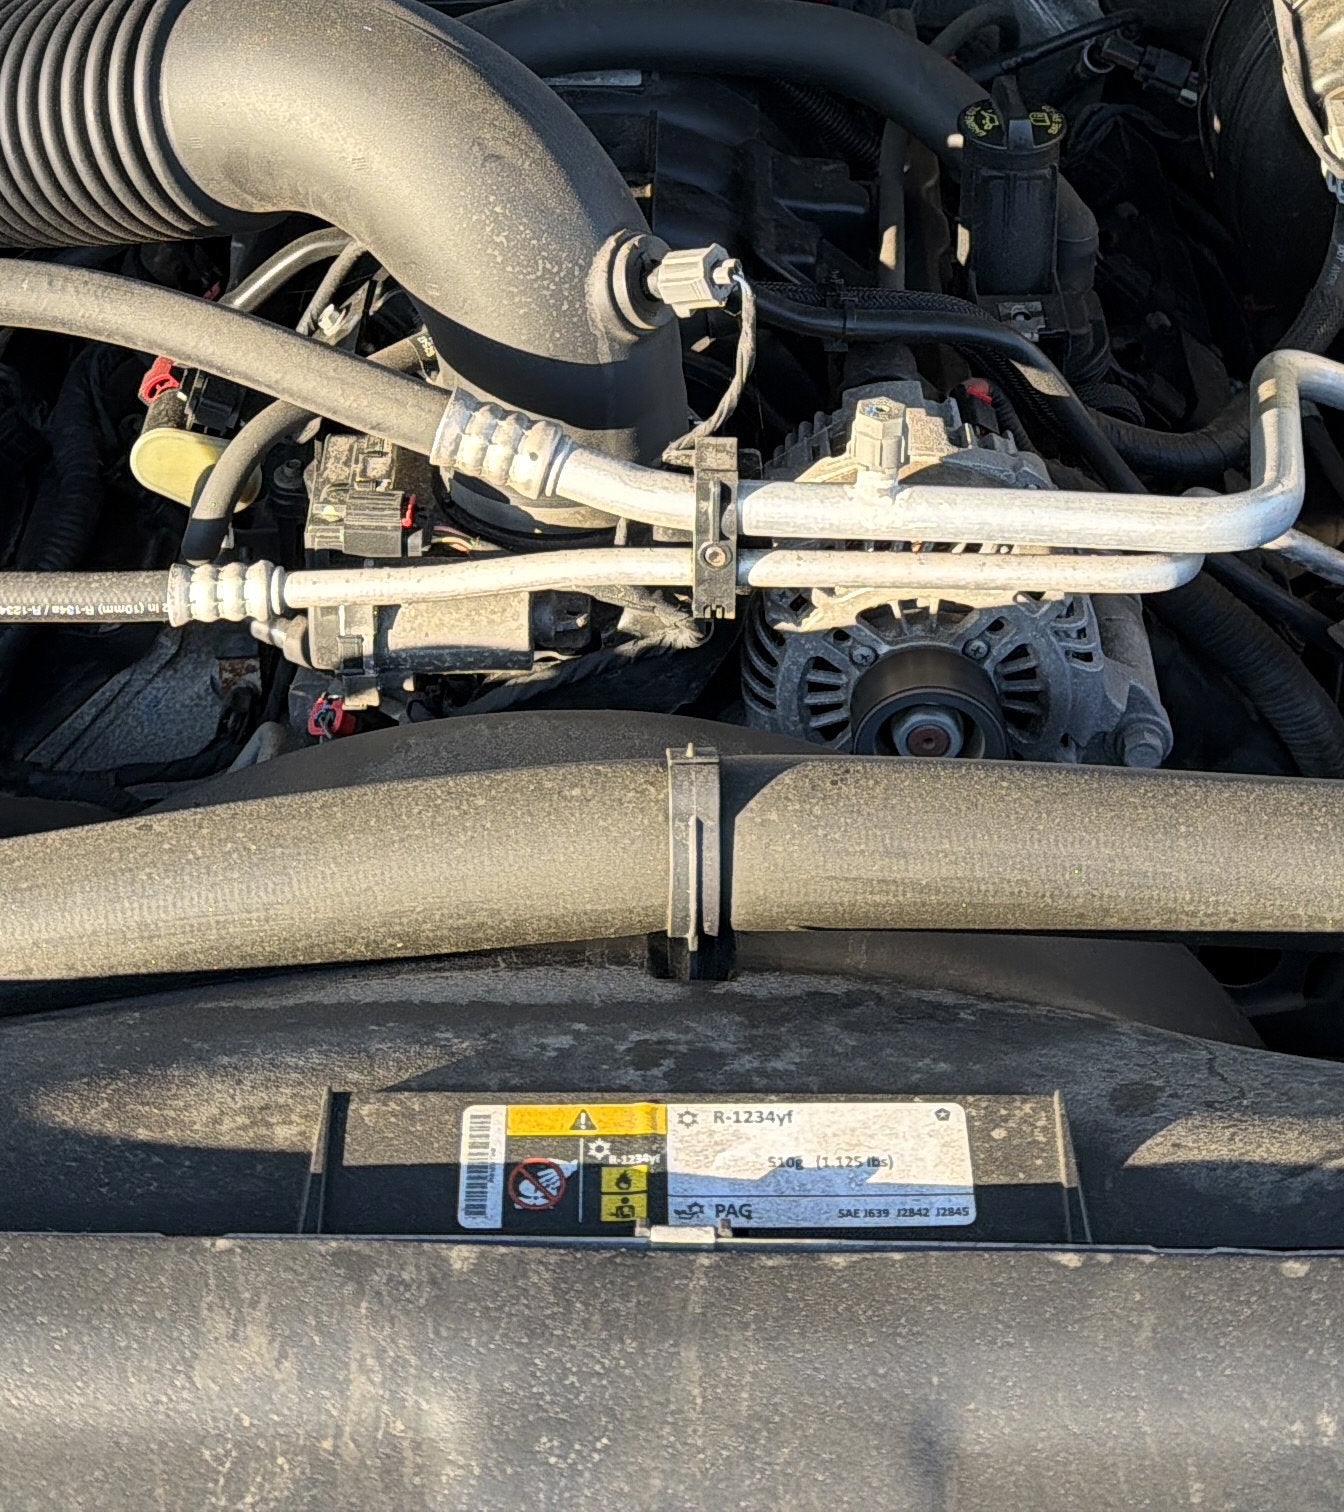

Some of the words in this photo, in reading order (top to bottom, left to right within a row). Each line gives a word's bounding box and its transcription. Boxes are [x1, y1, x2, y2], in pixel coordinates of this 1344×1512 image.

[713, 1109, 794, 1128] R-1234yf
[608, 1153, 661, 1167] R-1234yf
[767, 1155, 804, 1171] 510g
[816, 1155, 864, 1170] (1.125
[714, 1203, 754, 1219] PAG
[838, 1208, 861, 1218] SAE
[896, 1207, 931, 1218] J2842
